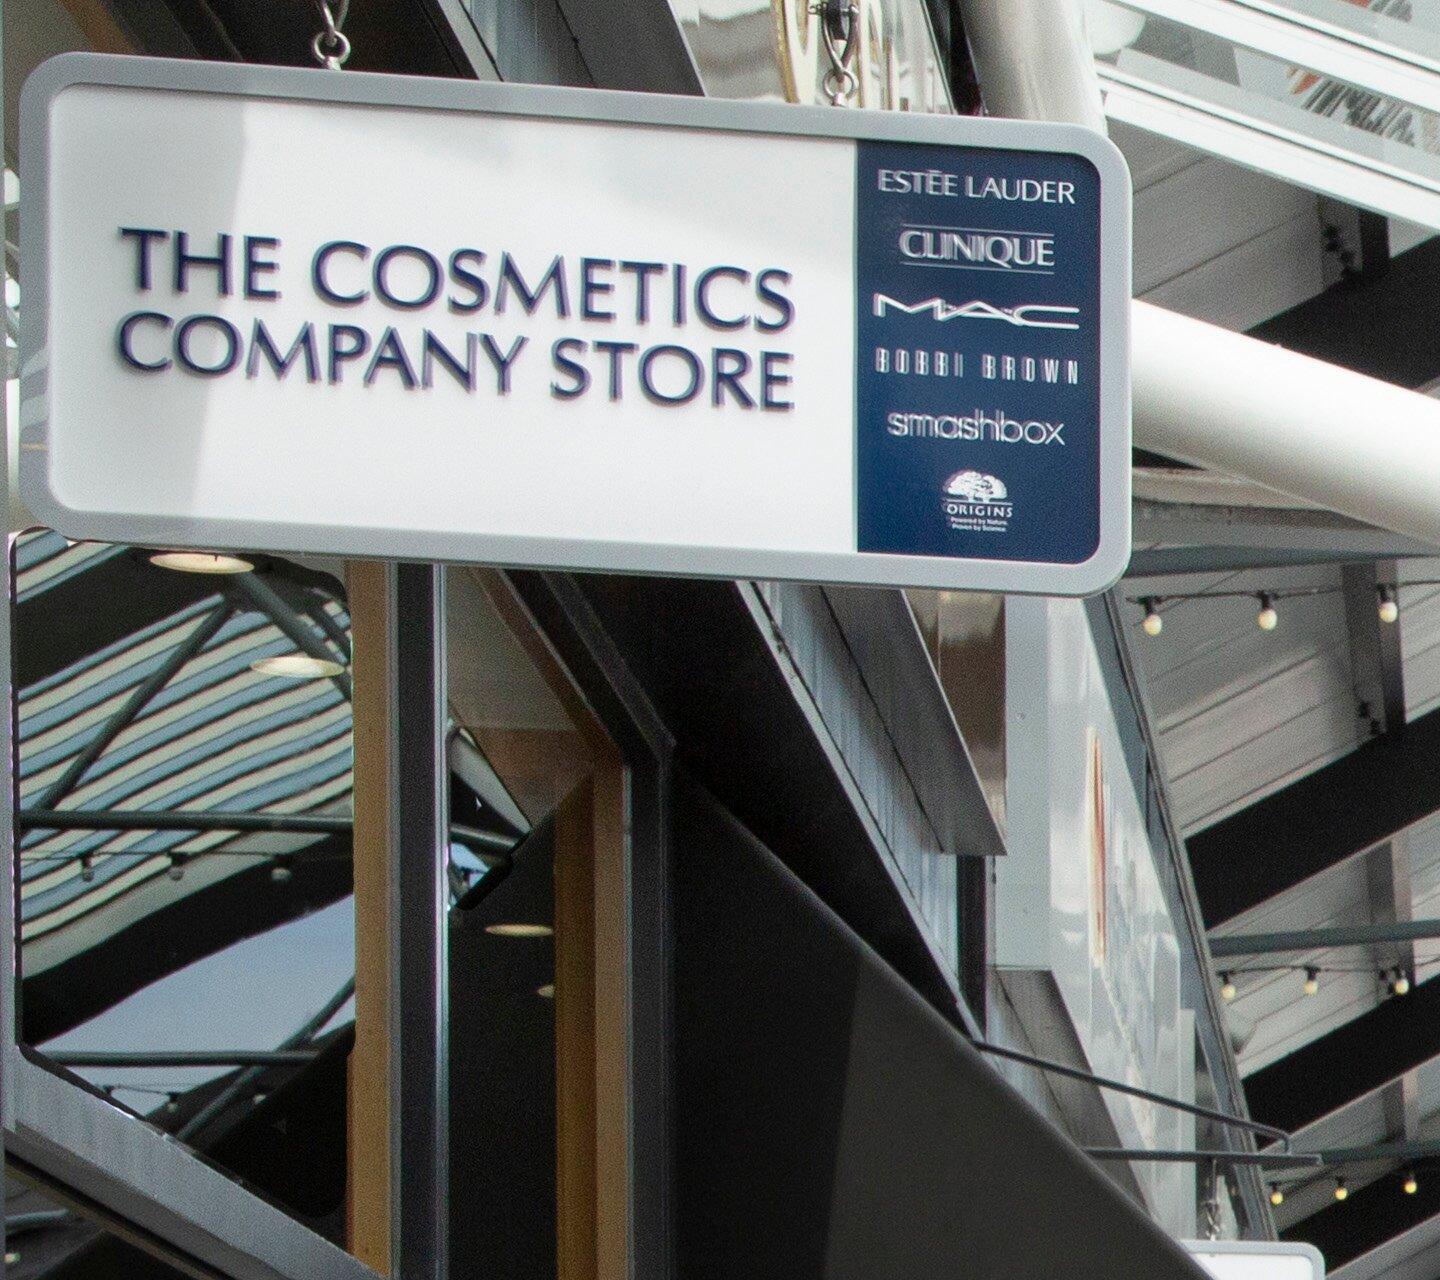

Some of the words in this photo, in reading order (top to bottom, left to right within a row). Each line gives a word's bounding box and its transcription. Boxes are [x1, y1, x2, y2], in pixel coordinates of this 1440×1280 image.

[965, 175, 1076, 204] LAUDER
[900, 230, 1055, 268] CLINIQUE
[119, 227, 282, 301] THE
[311, 240, 795, 332] COSMETICS
[116, 311, 530, 396] COMPANY
[551, 338, 795, 411] STORE
[876, 348, 963, 377] BOBBI
[982, 354, 1078, 384] BROWN
[888, 409, 1066, 446] smashbox
[946, 503, 1014, 518] ORIGINS
